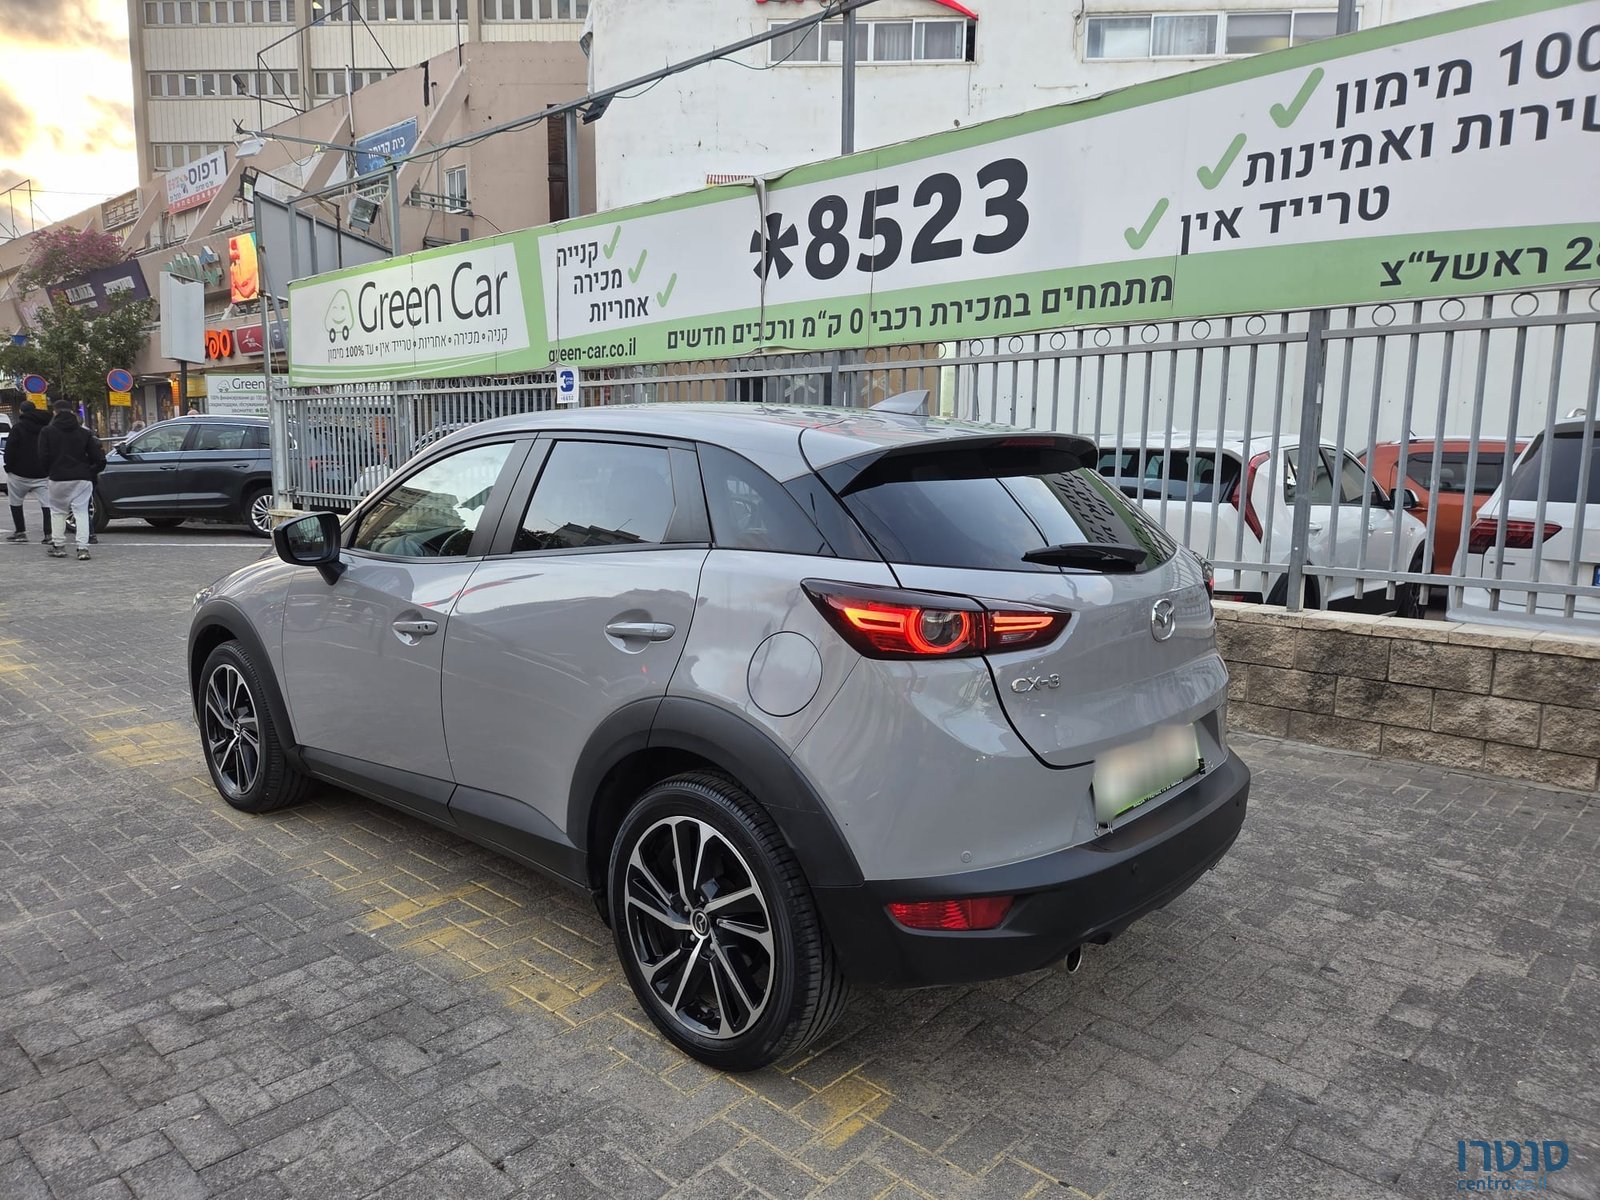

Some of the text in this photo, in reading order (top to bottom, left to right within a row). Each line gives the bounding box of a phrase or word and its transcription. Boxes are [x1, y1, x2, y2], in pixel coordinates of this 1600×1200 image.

[1336, 58, 1473, 129] מימון
[1242, 121, 1435, 188] ואמינות
[188, 157, 218, 185] דפוס
[1180, 184, 1391, 256] טרייד אין
[557, 241, 599, 268] קנייה
[573, 268, 623, 295] מכירה
[1041, 274, 1173, 314] מתמחים
[358, 261, 508, 333] Green Car
[589, 296, 650, 323] אחריות
[930, 292, 1031, 326] במכירת
[732, 319, 795, 344] ורכבים
[849, 308, 864, 334] 0
[870, 305, 921, 332] רכבי
[364, 343, 374, 355] עד
[380, 341, 390, 357] אין
[391, 337, 412, 351] טרייד
[418, 334, 447, 350] אחריות
[453, 331, 480, 346] מכירה
[487, 327, 508, 345] קניה
[667, 326, 726, 349] חדשים
[345, 345, 364, 358] 100%
[232, 377, 265, 390] Green
[1011, 673, 1061, 693] CX-3
